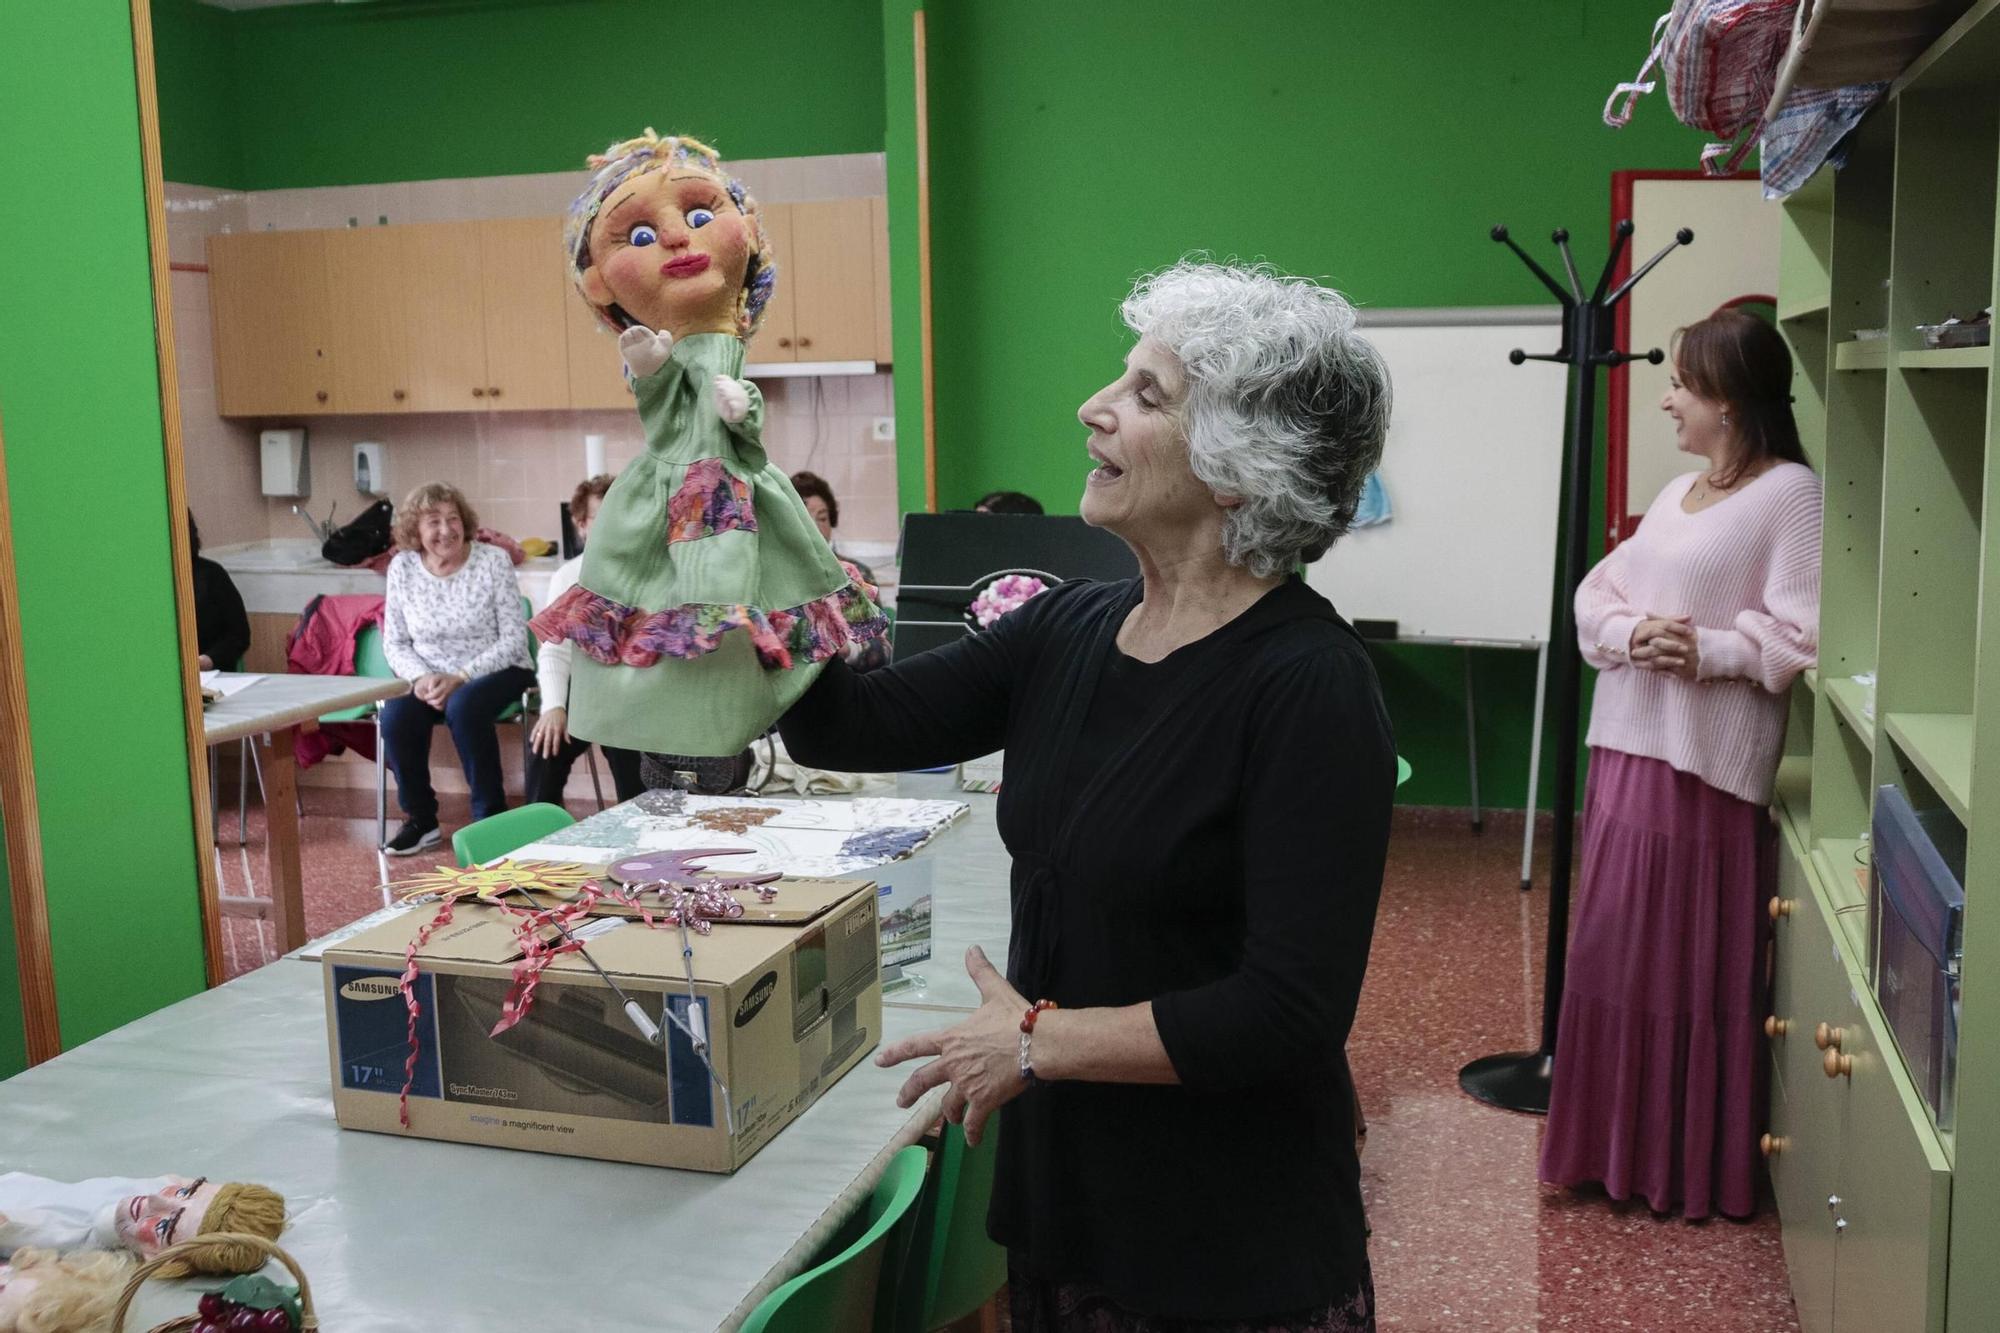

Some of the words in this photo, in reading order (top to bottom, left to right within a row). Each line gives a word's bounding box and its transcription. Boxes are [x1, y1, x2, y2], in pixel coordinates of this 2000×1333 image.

[348, 982, 399, 995] SAMSUNG
[739, 981, 774, 1016] SAMSUNG
[352, 1065, 384, 1083] 17"
[502, 1119, 508, 1127] a
[509, 1120, 555, 1132] magnificent
[557, 1126, 575, 1134] view
